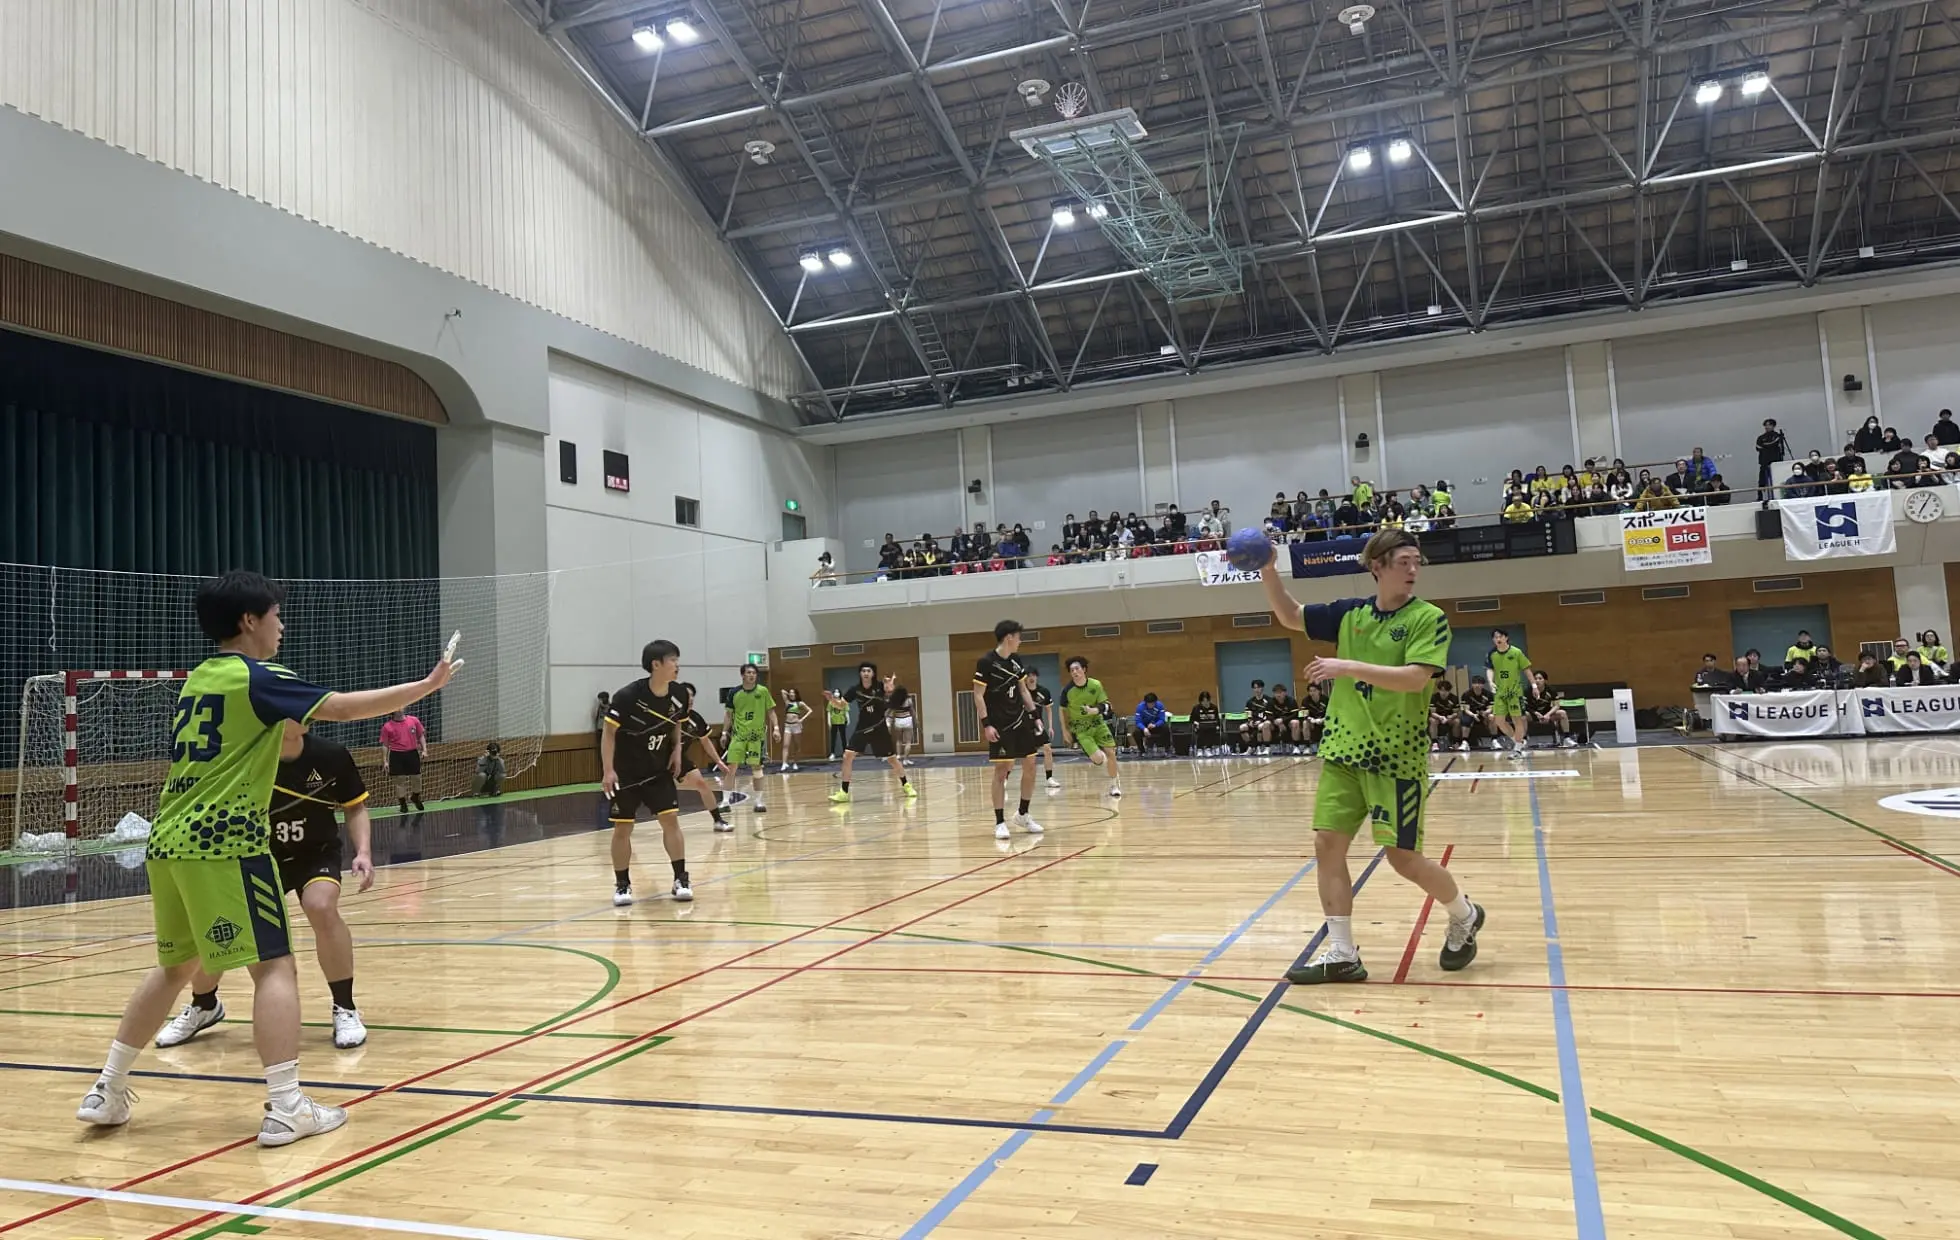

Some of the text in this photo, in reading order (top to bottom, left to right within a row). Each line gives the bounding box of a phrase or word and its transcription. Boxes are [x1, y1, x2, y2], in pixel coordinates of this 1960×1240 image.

[1623, 508, 1705, 529] スポーツくじ
[1818, 540, 1852, 550] LEAGUE
[1211, 571, 1262, 583] アルバモス
[1755, 702, 1847, 720] LEAGUE H
[171, 694, 226, 762] 23
[647, 735, 664, 751] 37
[276, 820, 305, 843] 35
